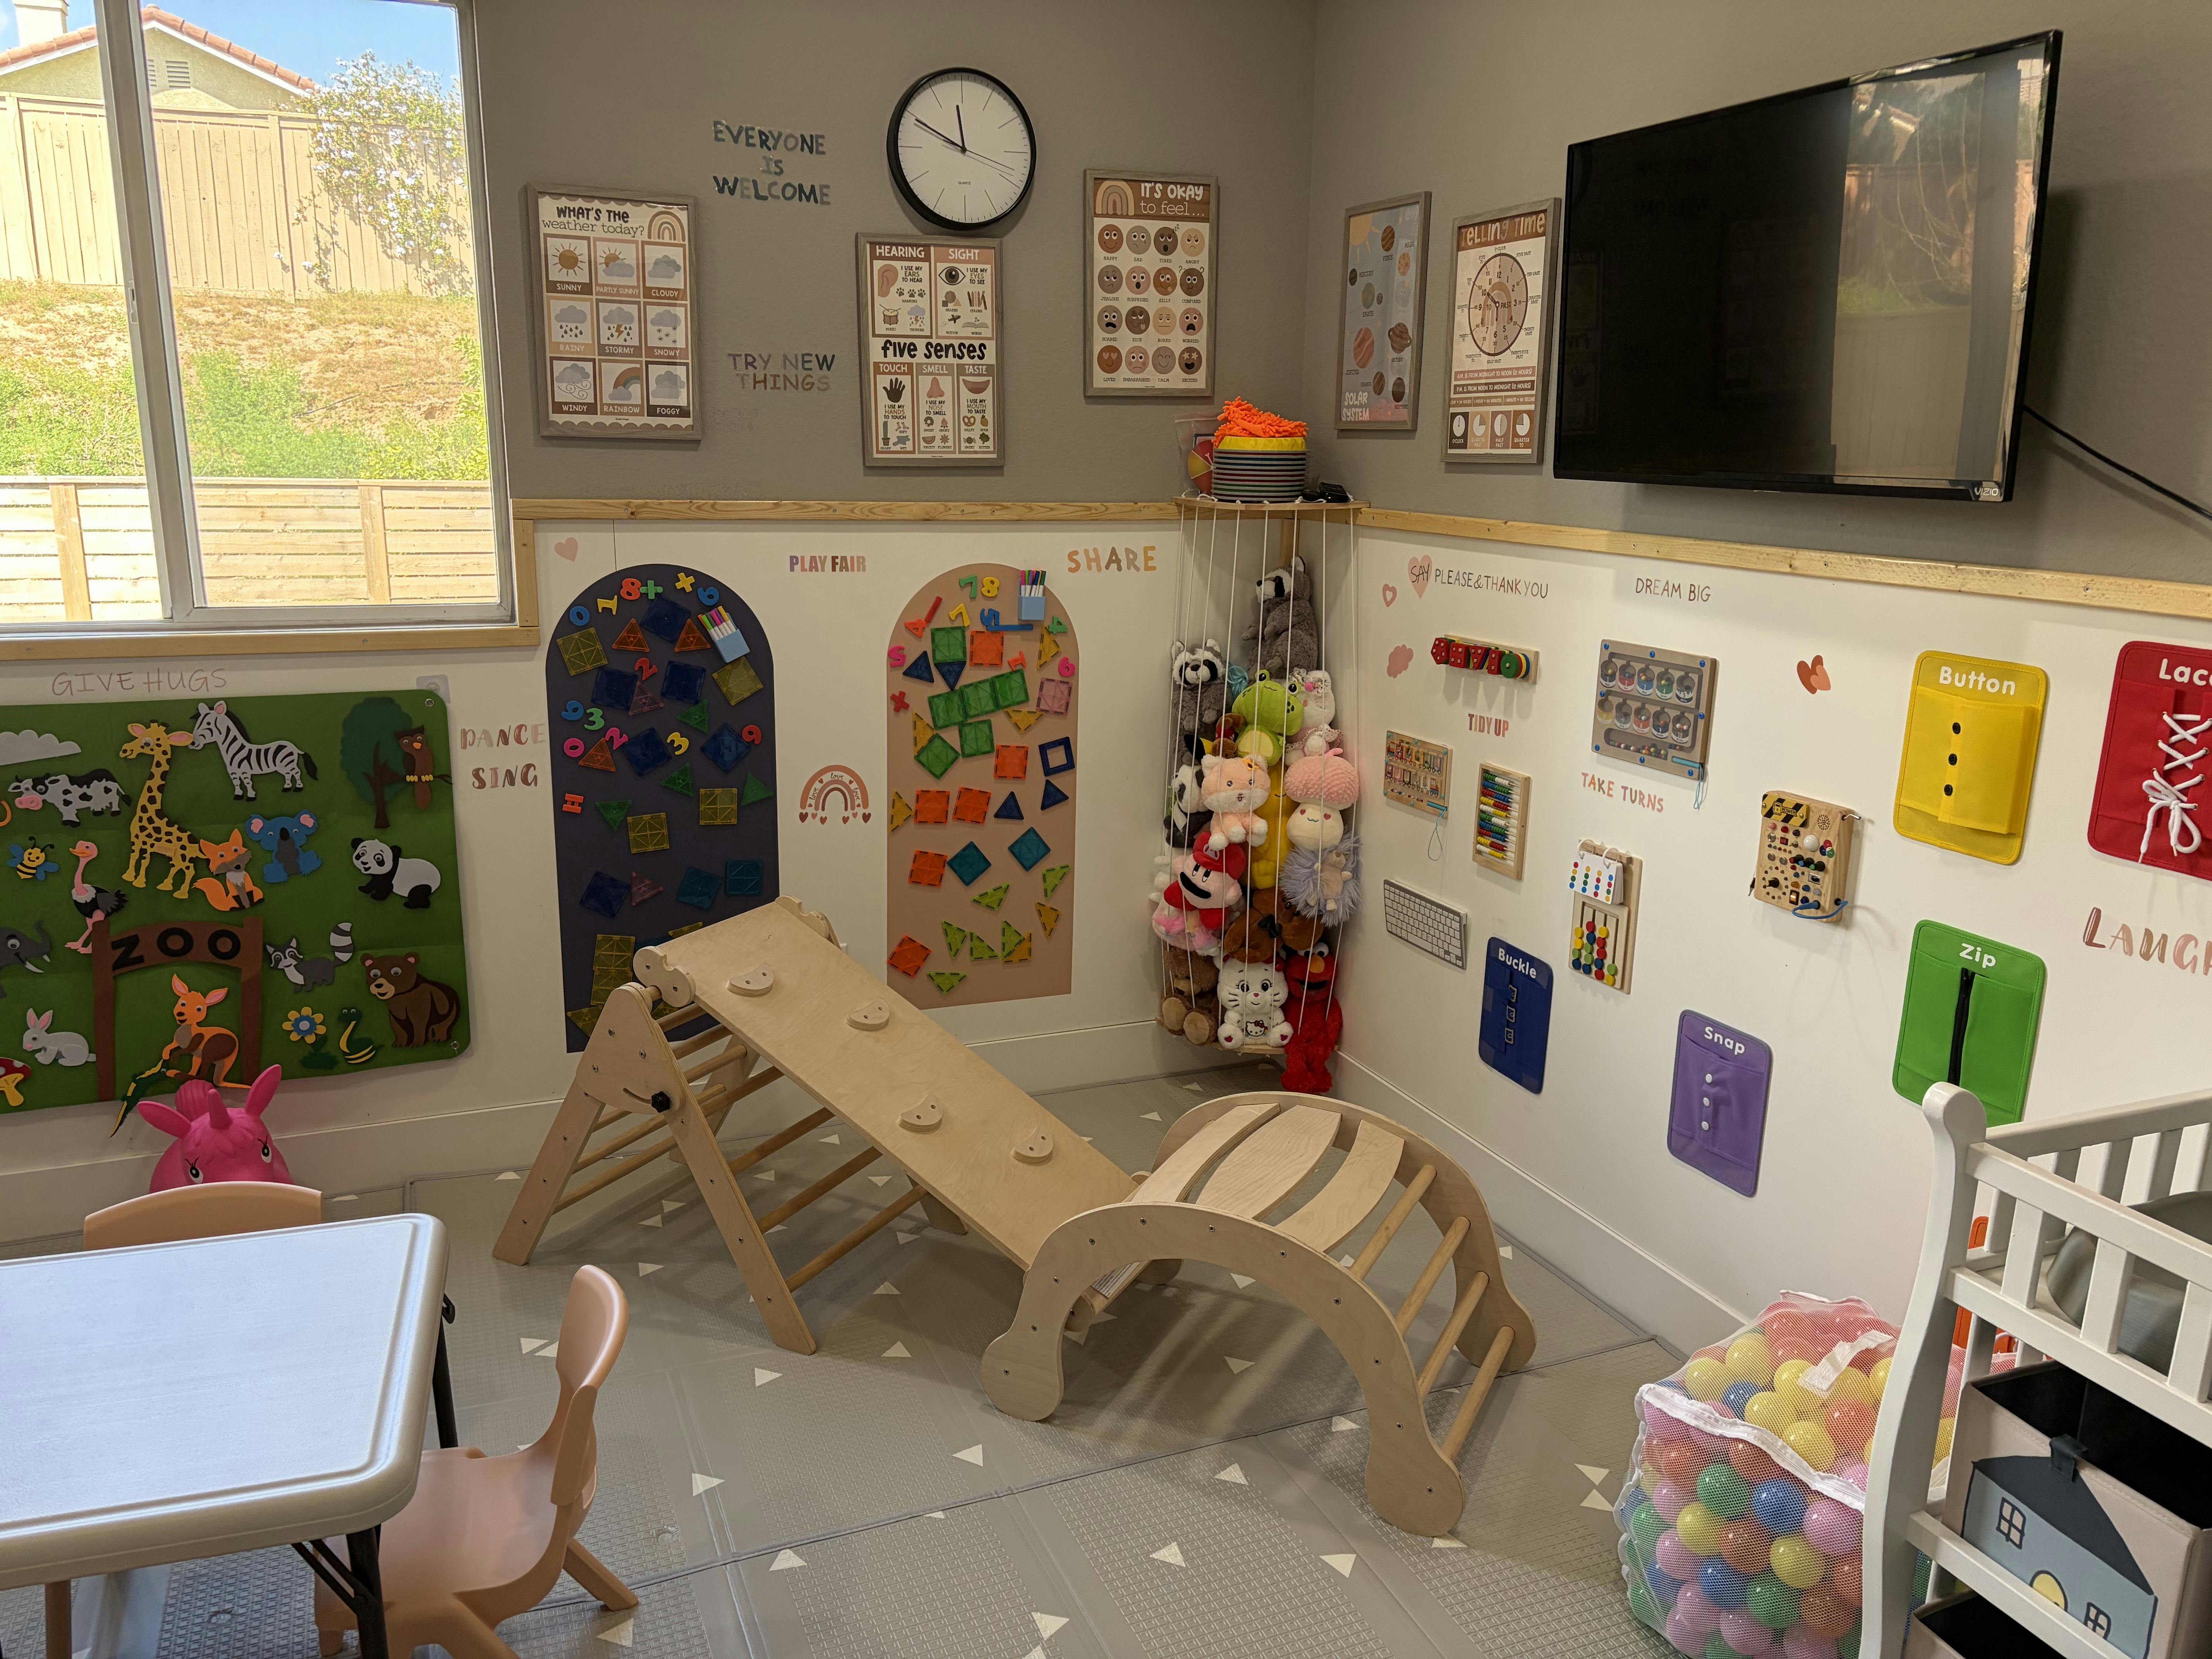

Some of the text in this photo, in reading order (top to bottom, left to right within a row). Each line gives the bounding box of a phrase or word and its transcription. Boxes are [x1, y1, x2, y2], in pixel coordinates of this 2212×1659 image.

[713, 120, 826, 155] EVERYONE
[761, 156, 783, 175] IS
[713, 176, 830, 205] WELCOME
[1141, 182, 1203, 201] IT'S OKAY
[556, 206, 601, 222] WHAT'S
[1140, 201, 1156, 213] to
[542, 220, 644, 238] weather today?
[876, 246, 925, 258] HEARING
[949, 249, 979, 260] SIGHT
[881, 339, 987, 360] five senses
[727, 353, 836, 371] TRY NEW
[879, 364, 907, 373] TOUCH
[922, 365, 948, 373] SMELL
[965, 366, 987, 374] TASTE
[737, 373, 830, 392] THINGS
[1345, 391, 1368, 405] SOLAR
[1342, 408, 1369, 421] SYSTEM
[1974, 487, 1999, 496] VIZIO
[790, 555, 866, 572] PLAY FAIR
[1068, 546, 1157, 573] SHARE
[1411, 563, 1430, 584] SAY
[1636, 578, 1711, 602] DREAM BIG
[52, 668, 227, 696] GIVE HUGS
[1939, 666, 2016, 696] Button
[1468, 713, 1509, 737] TIDY UP
[461, 724, 545, 750] DANCE
[472, 763, 538, 789] SING
[809, 788, 819, 800] love
[1582, 772, 1664, 812] TAKE TURNS
[111, 927, 241, 971] ZOO
[1959, 942, 1996, 969] Zip
[1498, 947, 1537, 980] Buckle
[1704, 1026, 1745, 1055] Snap
